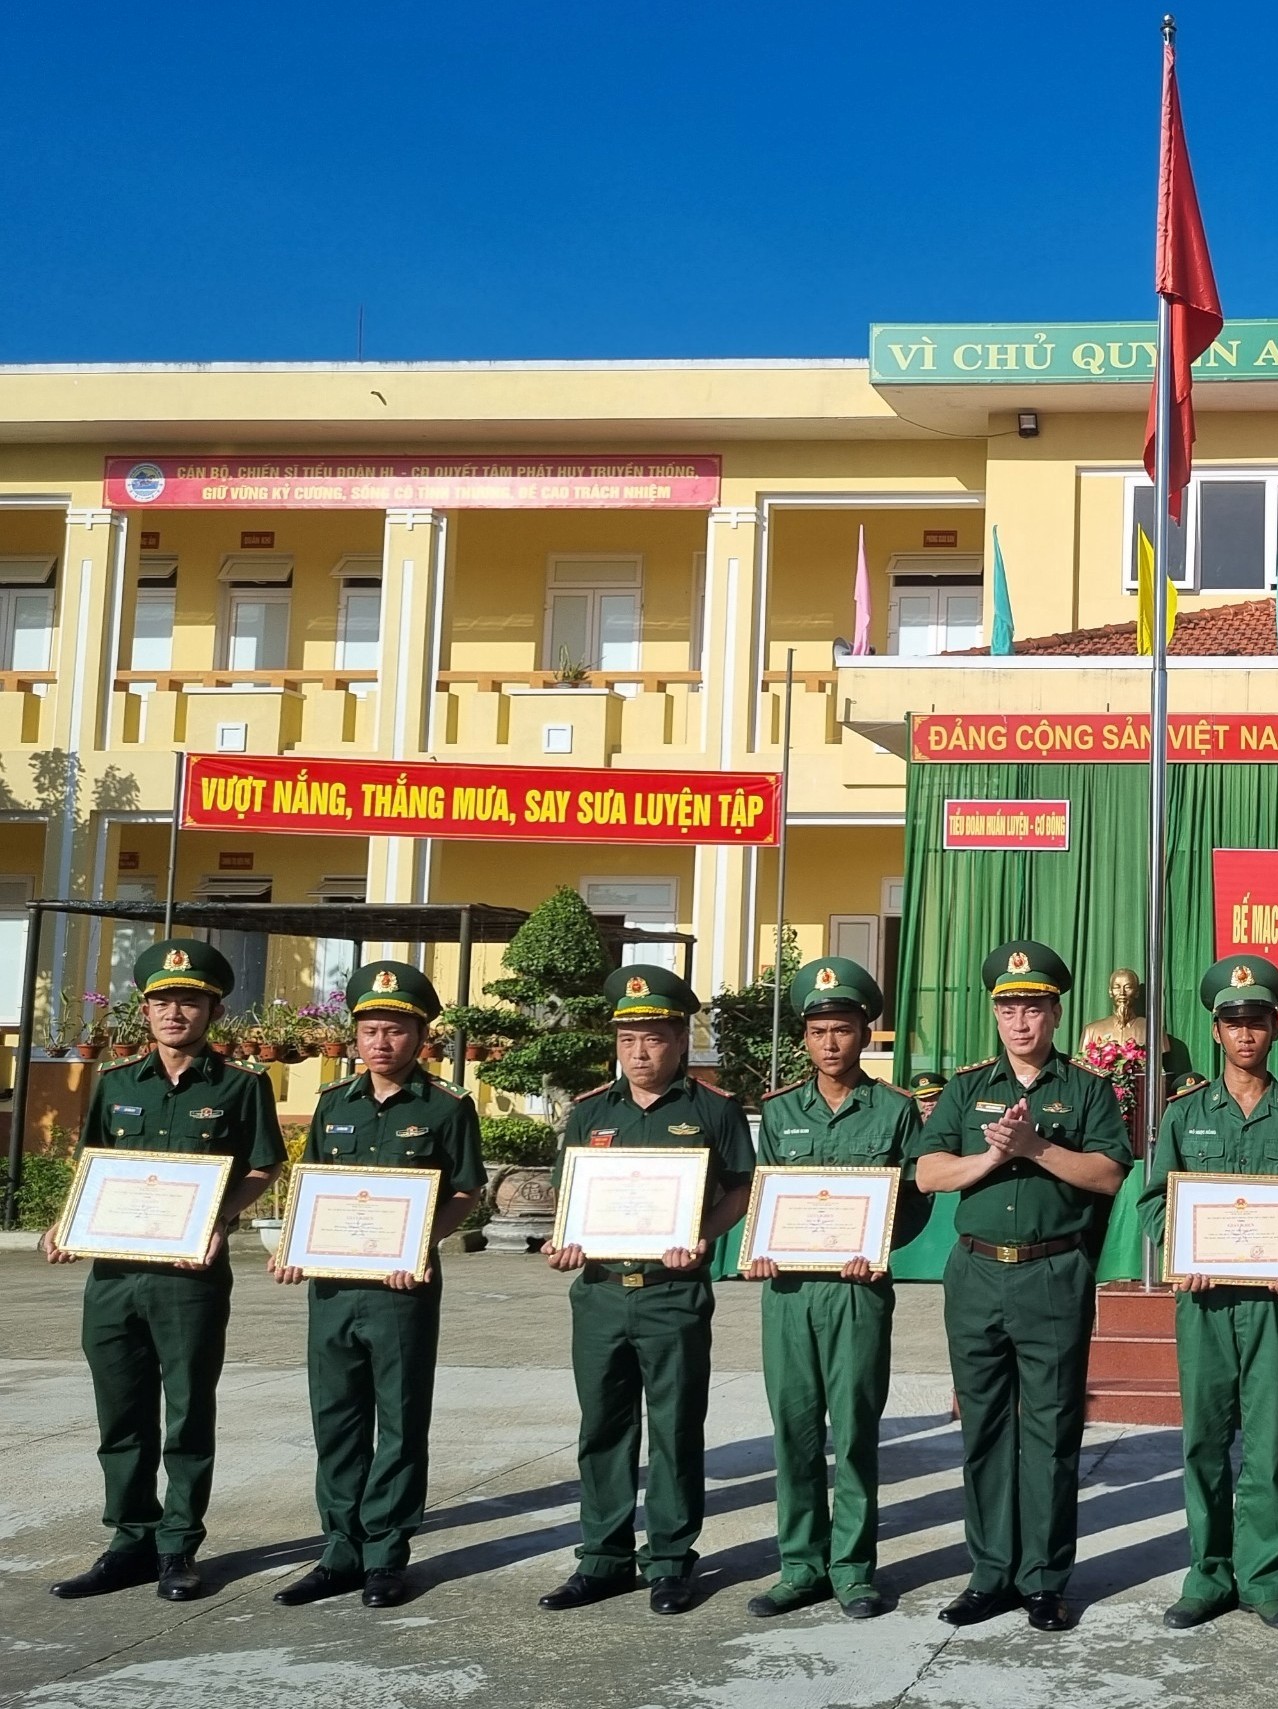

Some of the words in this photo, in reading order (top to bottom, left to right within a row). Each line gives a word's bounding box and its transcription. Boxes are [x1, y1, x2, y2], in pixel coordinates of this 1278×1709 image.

[888, 336, 937, 371] VÌ
[952, 332, 1055, 370] CHỦ
[177, 465, 206, 479] CÁN
[238, 464, 282, 479] CHIẾN
[286, 464, 300, 478] SĨ
[303, 462, 332, 477] TIỂU
[337, 464, 375, 477] ĐOÀN
[411, 466, 429, 477] CĐ
[434, 463, 478, 477] QUYẾT
[482, 464, 512, 477] TÂM
[517, 464, 553, 477] PHÁT
[558, 465, 585, 477] HUY
[589, 462, 644, 477] TRUYỀN
[202, 485, 230, 500] GIỮ
[230, 484, 268, 500] VỮNG
[272, 483, 290, 500] KỶ
[294, 486, 347, 502] CƯƠNG,
[541, 485, 569, 499] CAO
[574, 484, 620, 499] TRÁCH
[624, 483, 671, 502] NHIỆM
[928, 718, 1007, 751] ĐẢNG
[1015, 720, 1093, 756] CỘNG
[1101, 716, 1151, 750] SẢN
[1169, 720, 1230, 756] VIỆT
[201, 775, 267, 820] VƯỢT
[272, 768, 353, 820] NẮNG,
[362, 772, 444, 819] THẮNG
[452, 785, 516, 826] MƯA,
[524, 789, 571, 823] SAY
[577, 788, 627, 825] SƯA
[634, 787, 711, 833] LUYỆN
[718, 788, 764, 834] TẬP
[1232, 892, 1250, 944] BẾ
